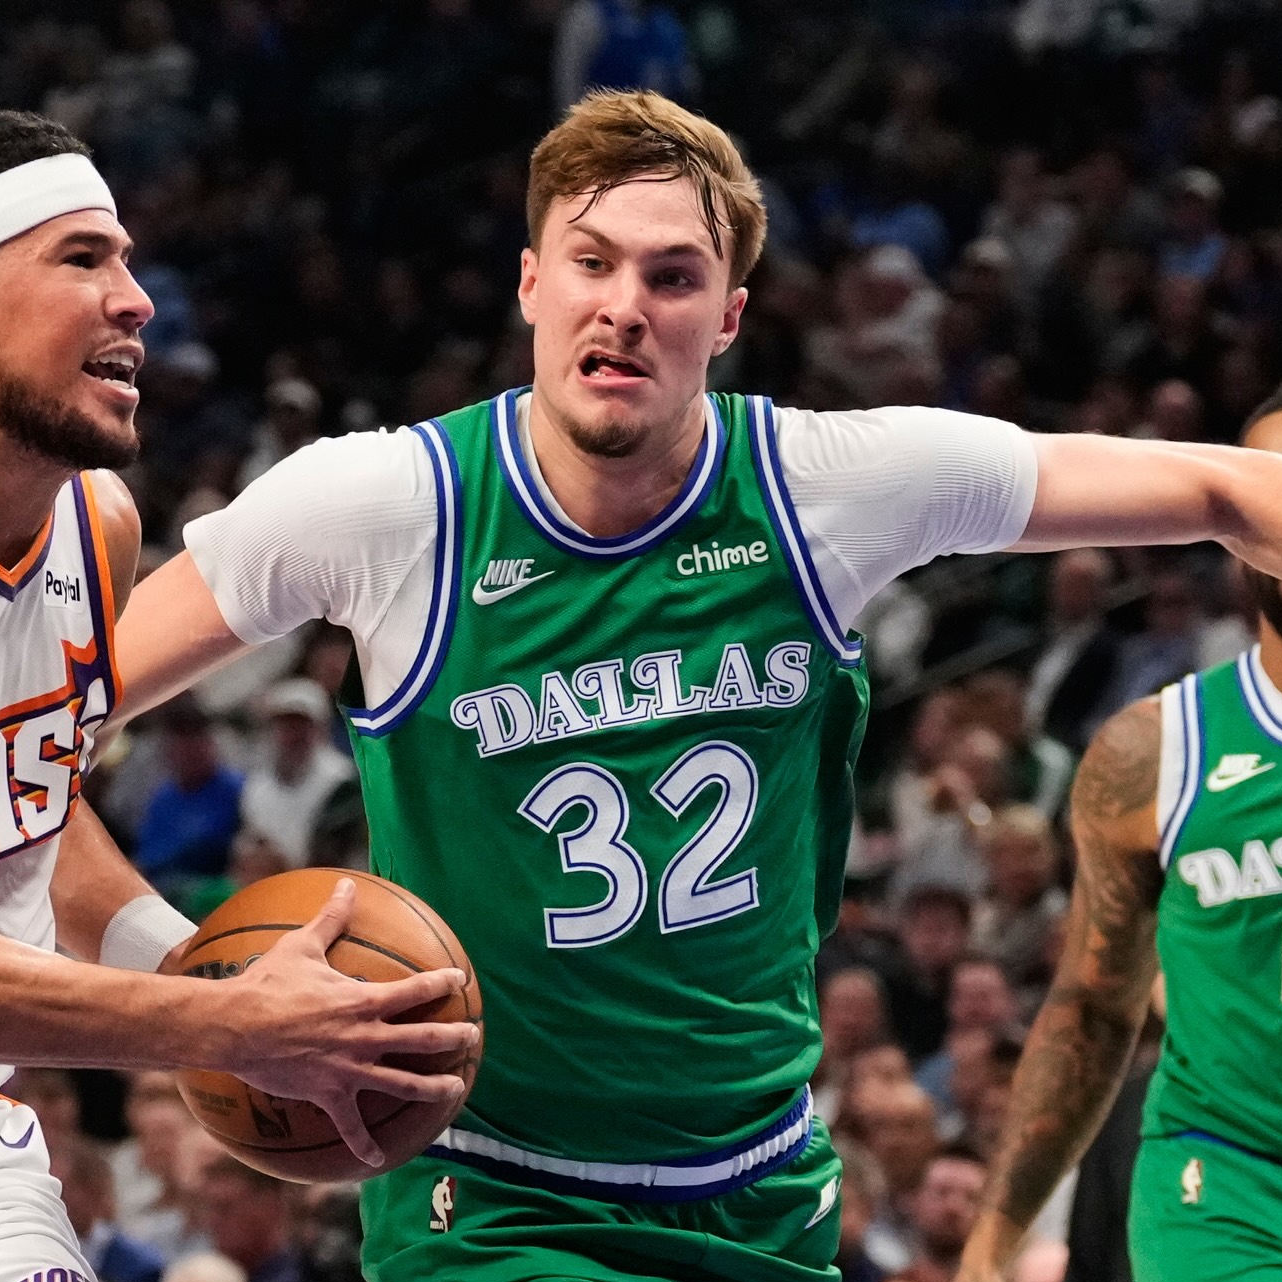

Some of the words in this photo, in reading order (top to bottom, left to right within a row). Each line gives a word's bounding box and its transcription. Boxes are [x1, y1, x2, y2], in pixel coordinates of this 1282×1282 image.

[482, 559, 535, 586] NIKE
[676, 540, 769, 576] chime
[451, 641, 813, 758] DALLAS
[517, 740, 760, 948] 32
